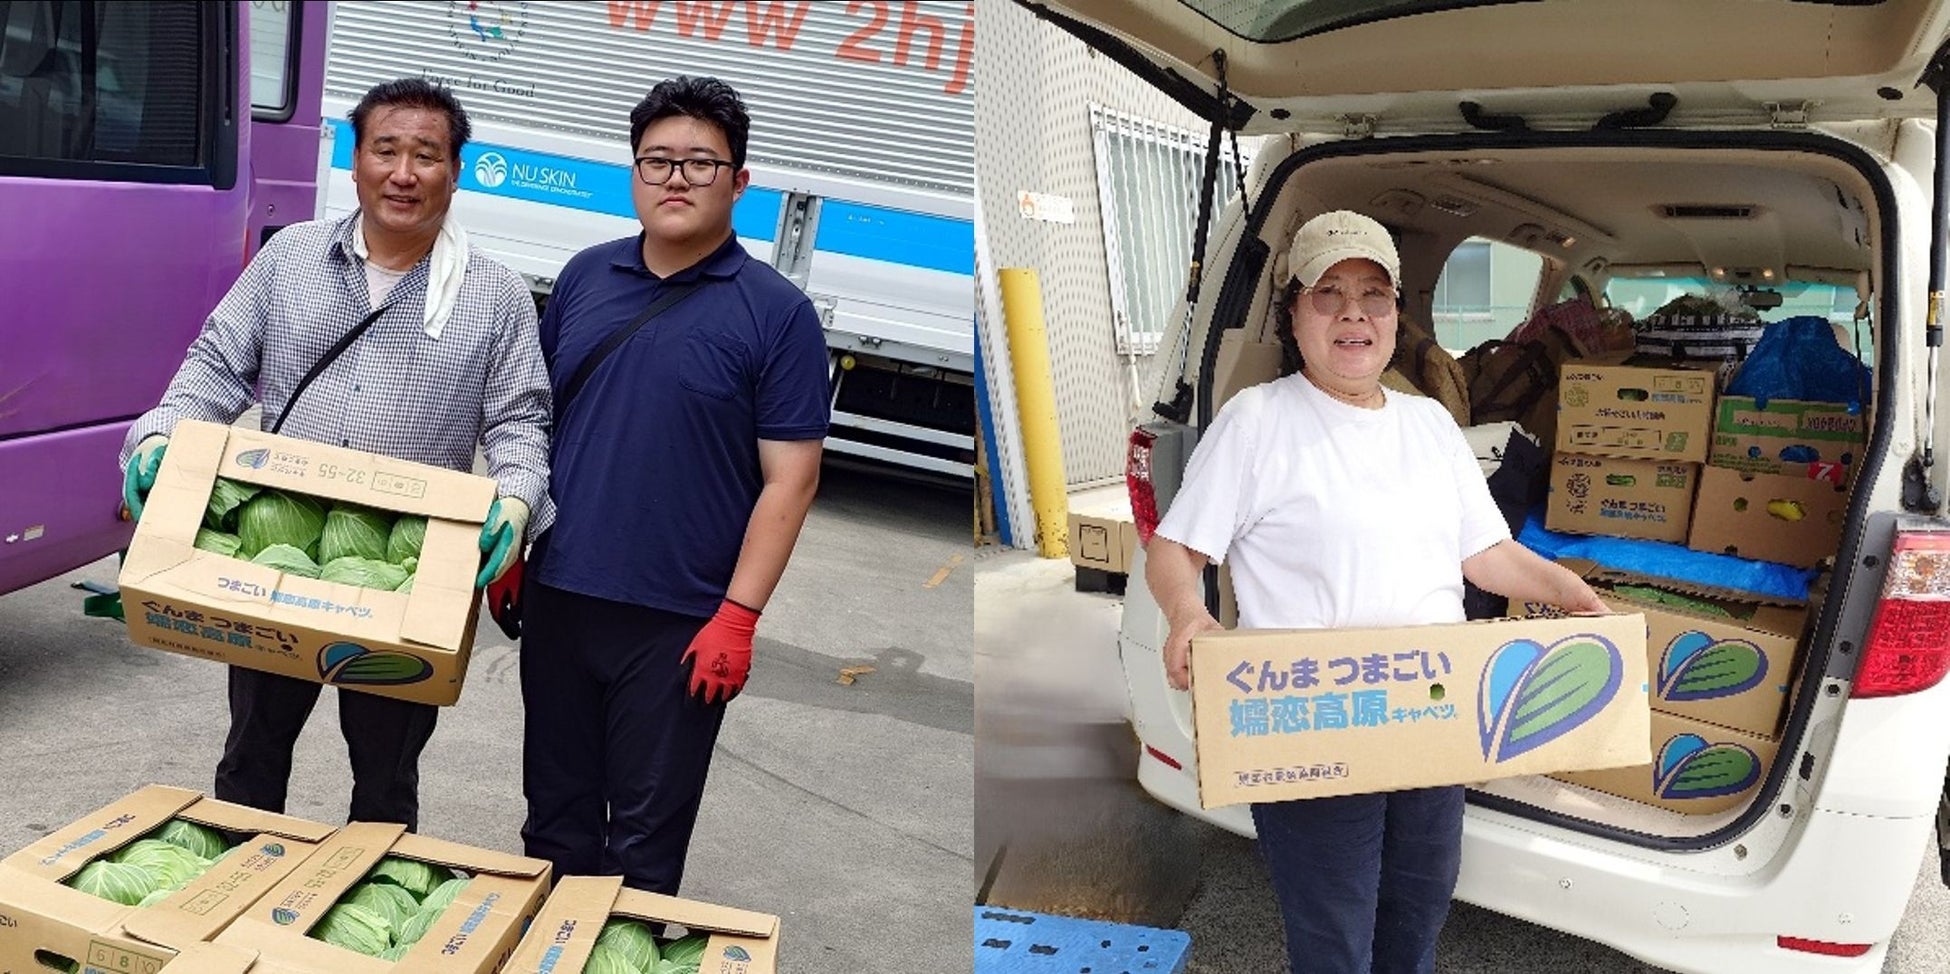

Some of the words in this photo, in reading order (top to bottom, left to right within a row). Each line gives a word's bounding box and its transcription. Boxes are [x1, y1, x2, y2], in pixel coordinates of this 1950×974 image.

[493, 79, 536, 97] Good
[512, 163, 538, 181] NU
[540, 167, 577, 188] SKIN
[217, 576, 266, 597] つまごい
[141, 600, 205, 626] ぐんま
[210, 614, 301, 645] つまごい
[1226, 657, 1320, 694] ぐんま
[1328, 650, 1452, 685] つまごい
[120, 956, 129, 968] 8
